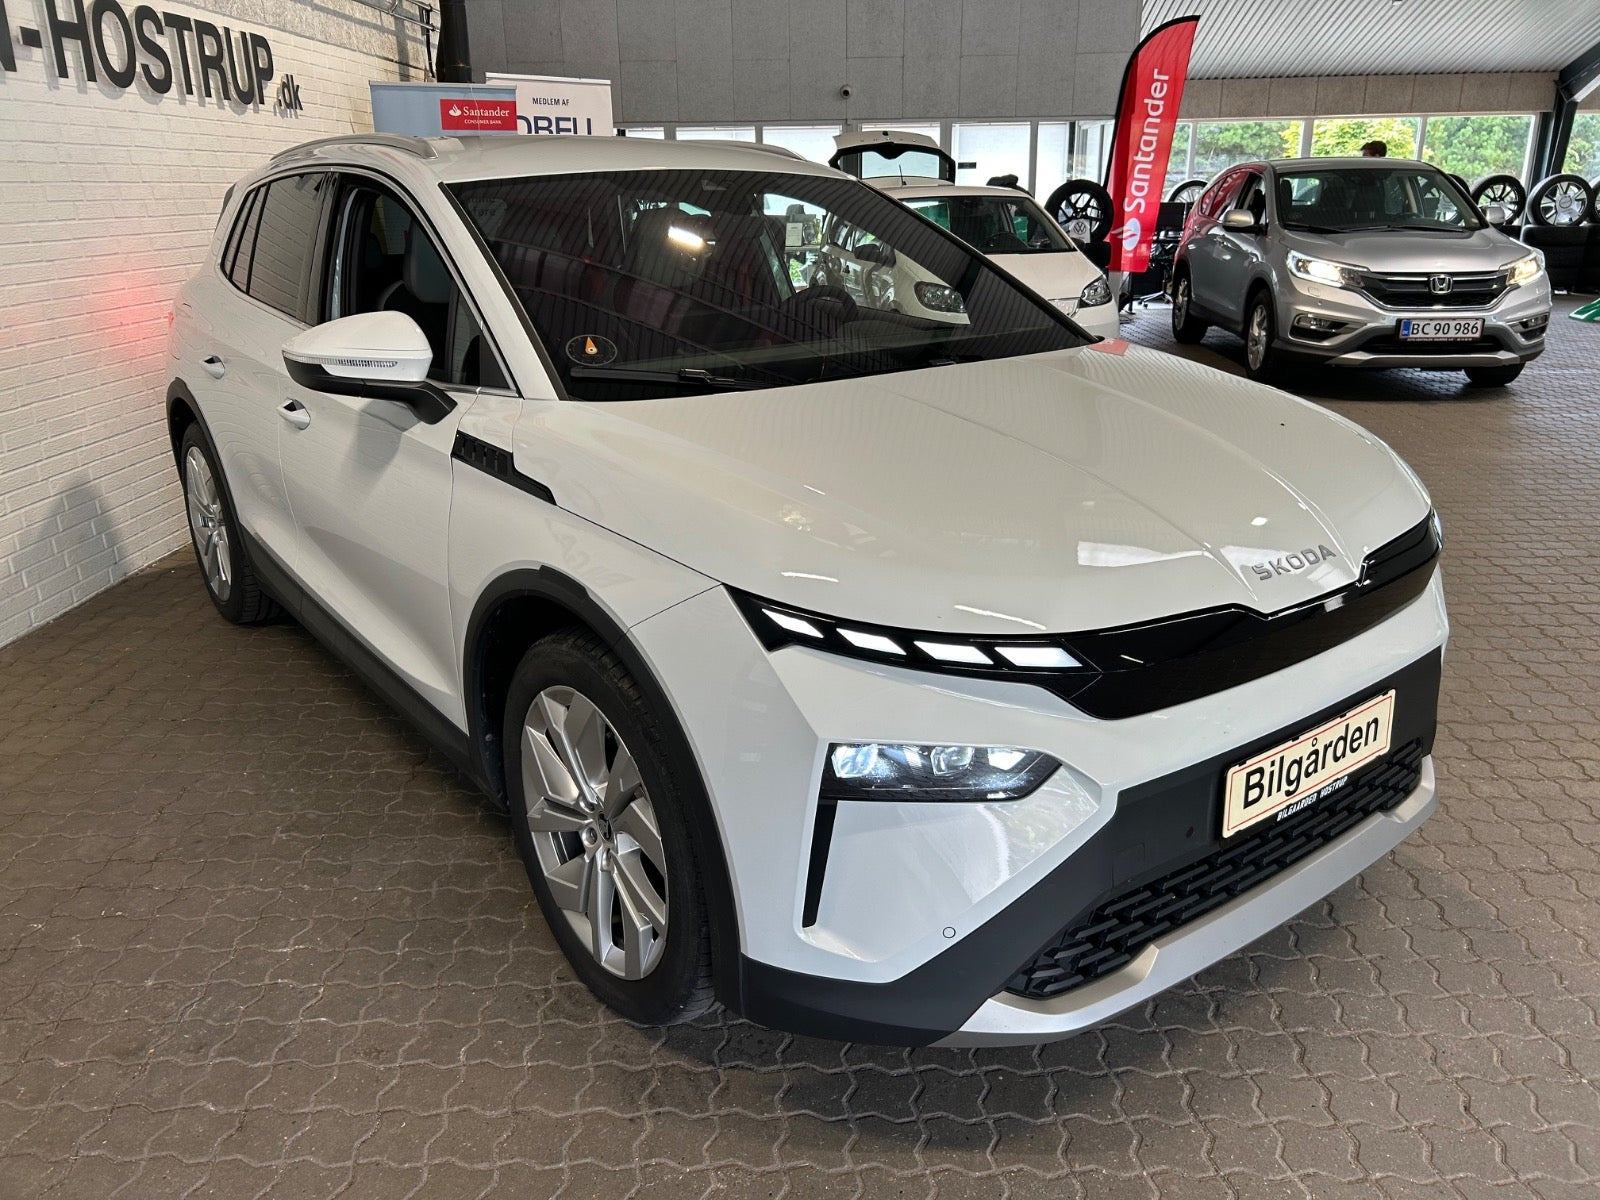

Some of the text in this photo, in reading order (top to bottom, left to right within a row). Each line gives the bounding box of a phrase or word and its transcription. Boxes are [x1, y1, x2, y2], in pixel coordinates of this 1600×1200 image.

[0, 0, 303, 111] -HOSTRUP.dk
[463, 106, 510, 117] Santander
[532, 97, 560, 106] MEDLEM
[1123, 68, 1170, 214] Santander
[1411, 323, 1431, 335] BC
[1433, 323, 1450, 335] 90
[1454, 322, 1479, 335] 986
[1243, 717, 1379, 810] Bilgården
[1319, 775, 1348, 799] HOSTRUP
